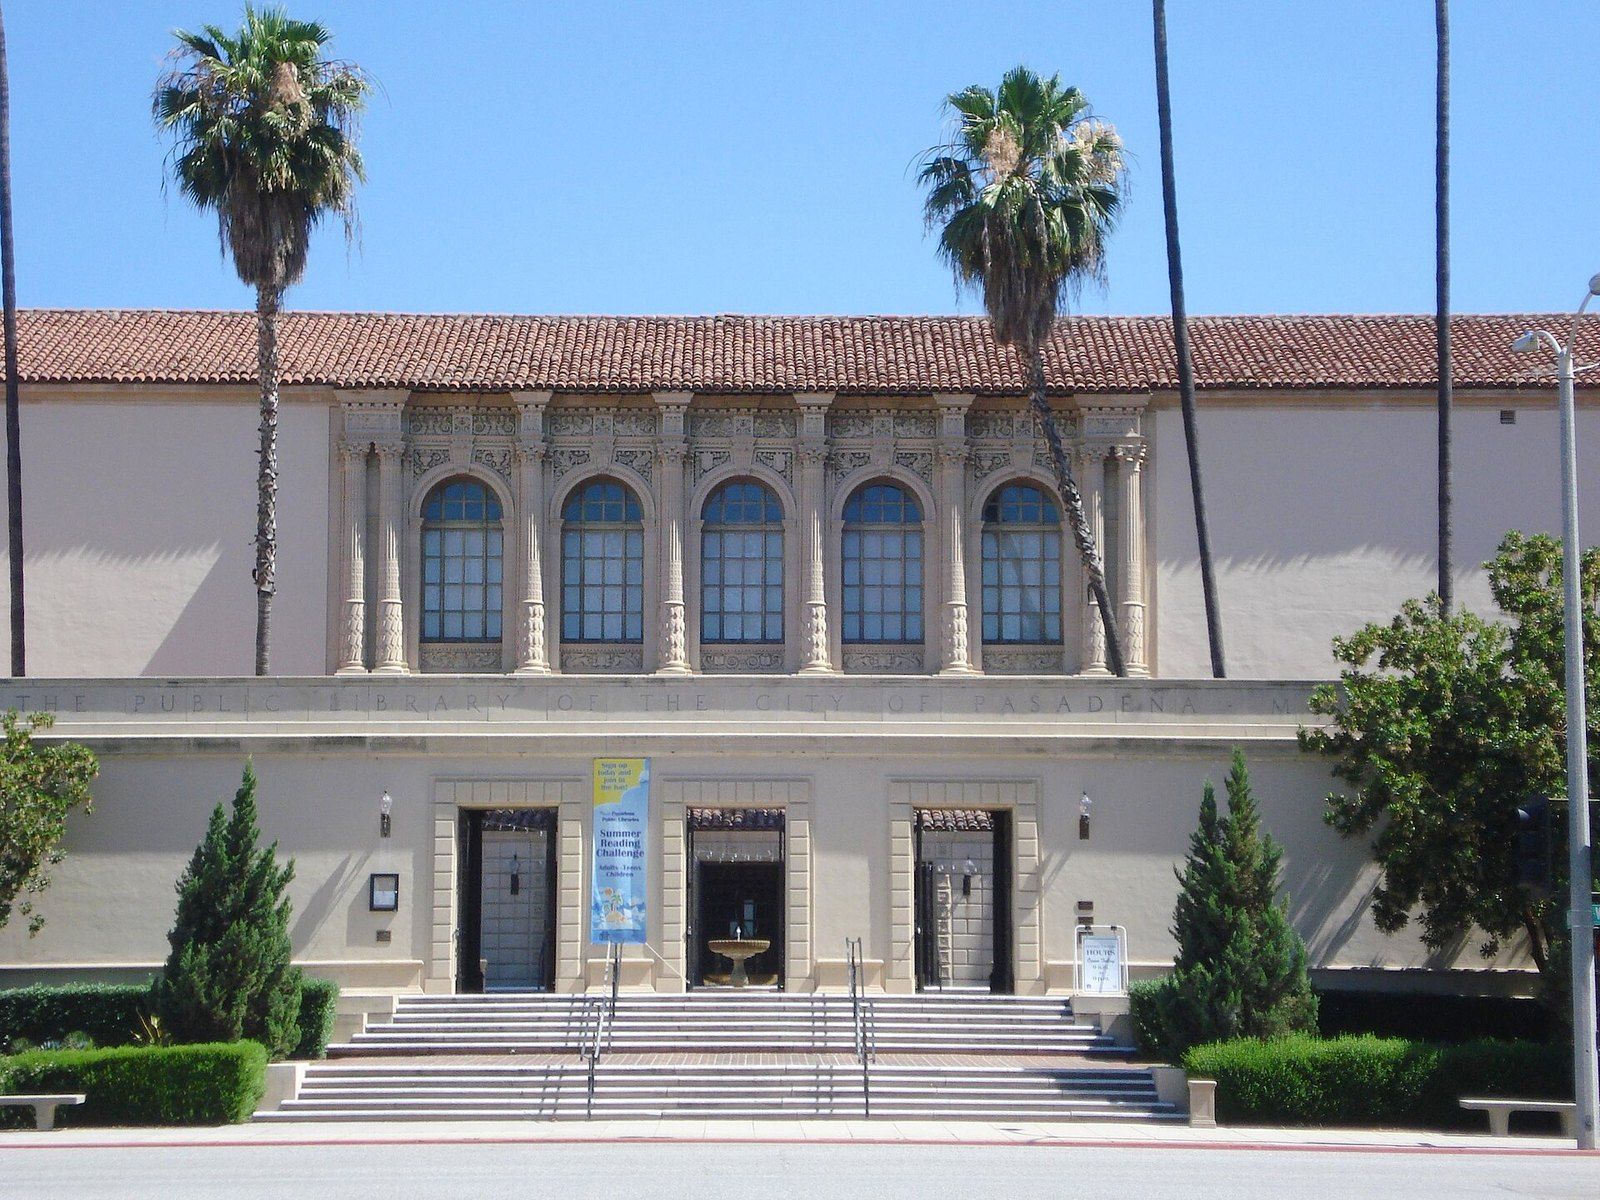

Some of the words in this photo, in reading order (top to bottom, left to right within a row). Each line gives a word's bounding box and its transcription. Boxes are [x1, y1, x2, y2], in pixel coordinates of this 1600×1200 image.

[15, 694, 88, 713] THE
[133, 693, 280, 713] PUBLIC
[329, 693, 510, 713] LIBRARY
[557, 693, 599, 712] OF
[640, 693, 709, 712] THE
[755, 693, 844, 712] CITY
[888, 694, 930, 713] OF
[973, 693, 1198, 714] PASADENA
[600, 829, 641, 838] Summer
[600, 839, 641, 849] Reading
[596, 848, 645, 859] Challenge
